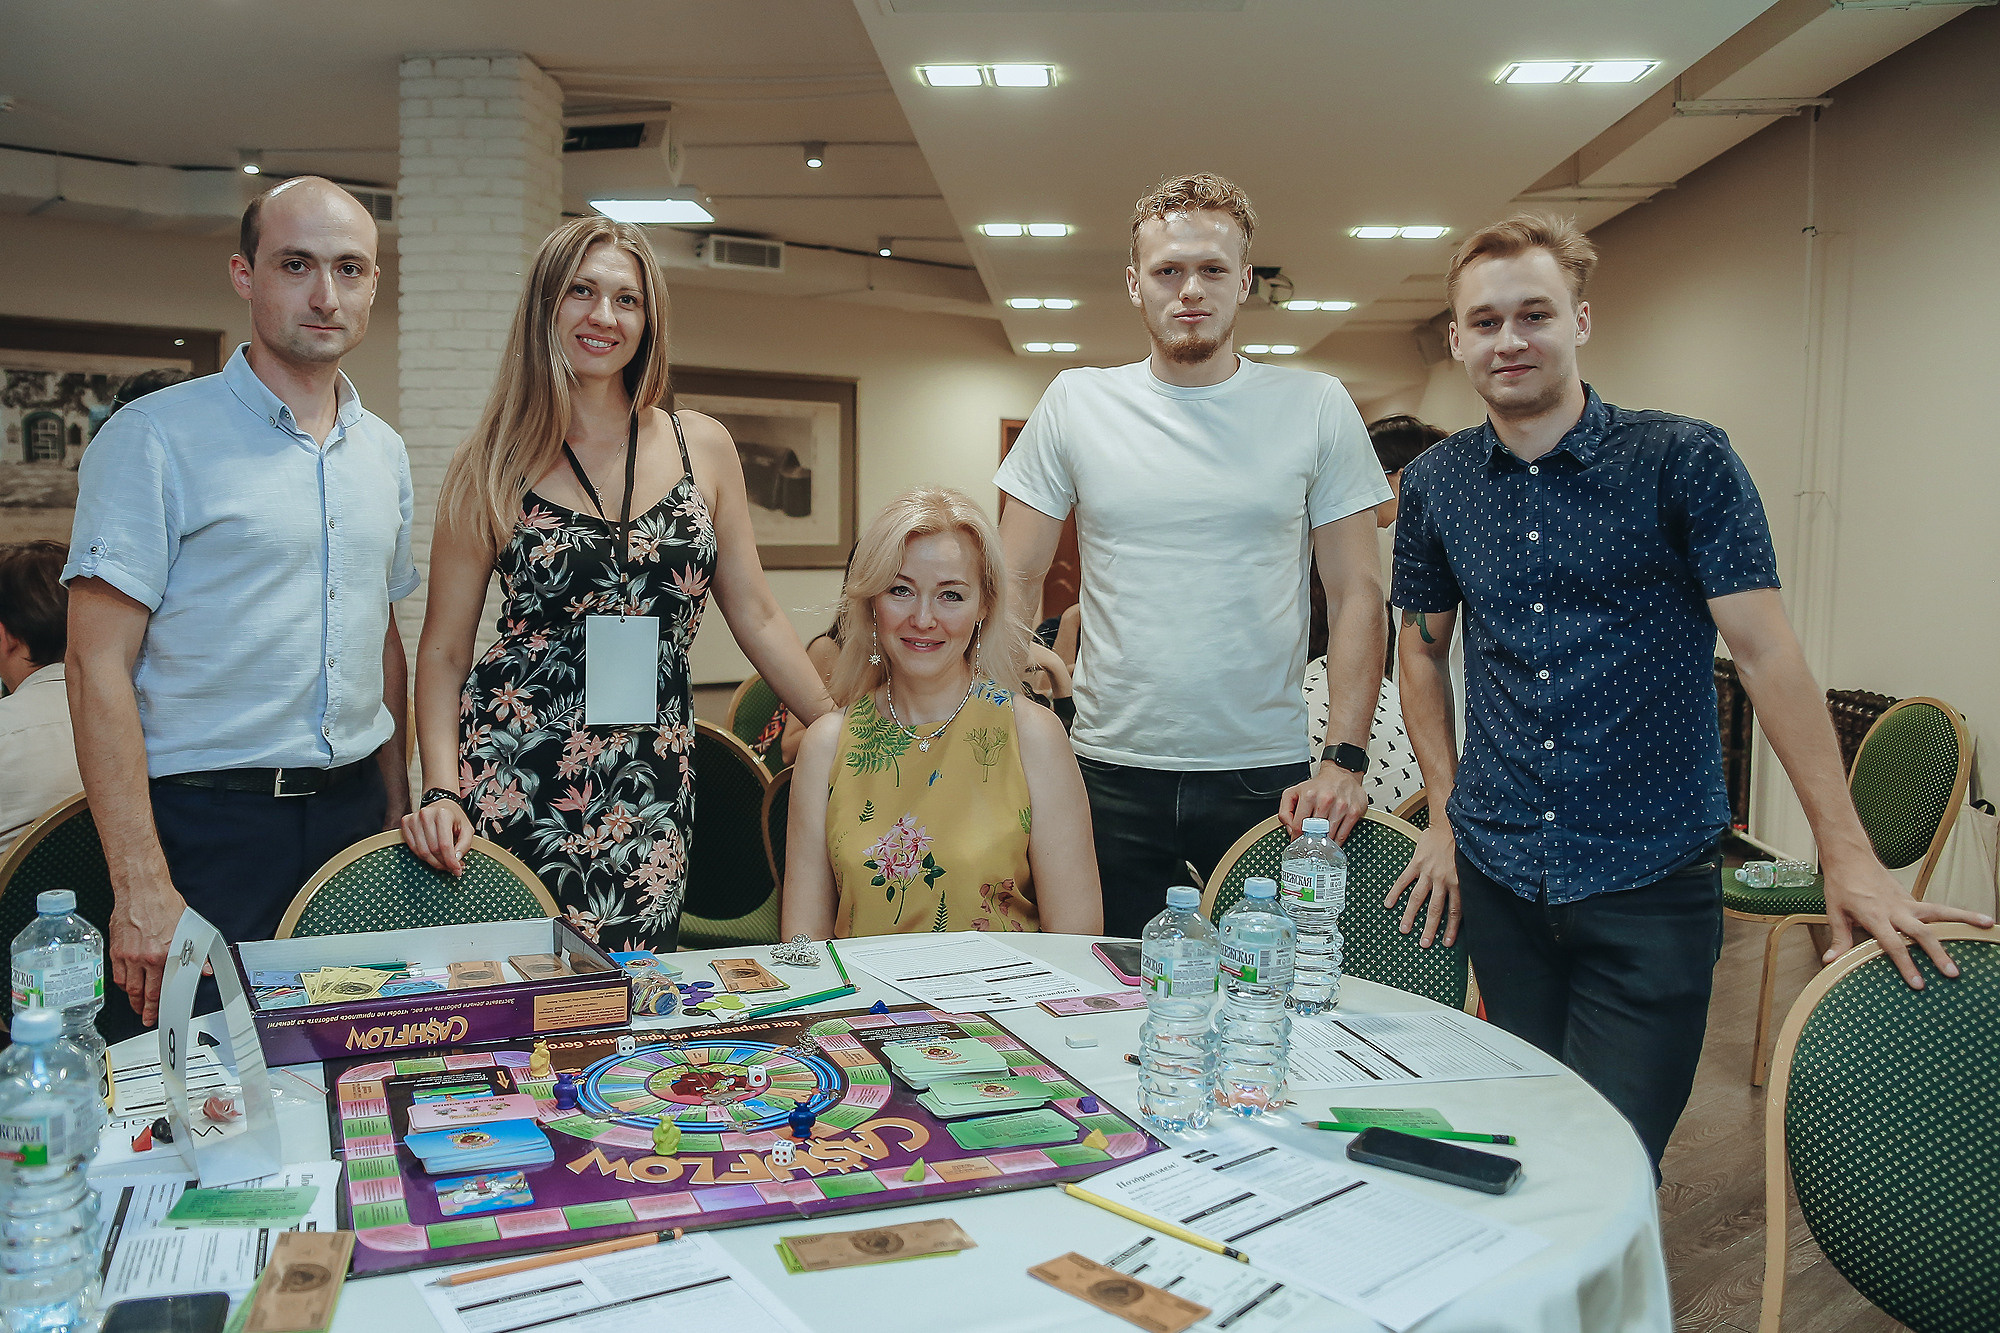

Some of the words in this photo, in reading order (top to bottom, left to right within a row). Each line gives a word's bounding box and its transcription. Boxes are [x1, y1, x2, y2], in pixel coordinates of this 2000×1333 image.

[434, 1002, 462, 1011] работать
[462, 1001, 485, 1009] деньги
[340, 1012, 376, 1020] пришлось
[386, 1009, 409, 1017] чтобы
[266, 1019, 297, 1029] деньги!
[306, 1015, 339, 1024] работать
[772, 1020, 802, 1028] Как
[690, 1023, 771, 1038] вырваться
[546, 1040, 585, 1050] бего
